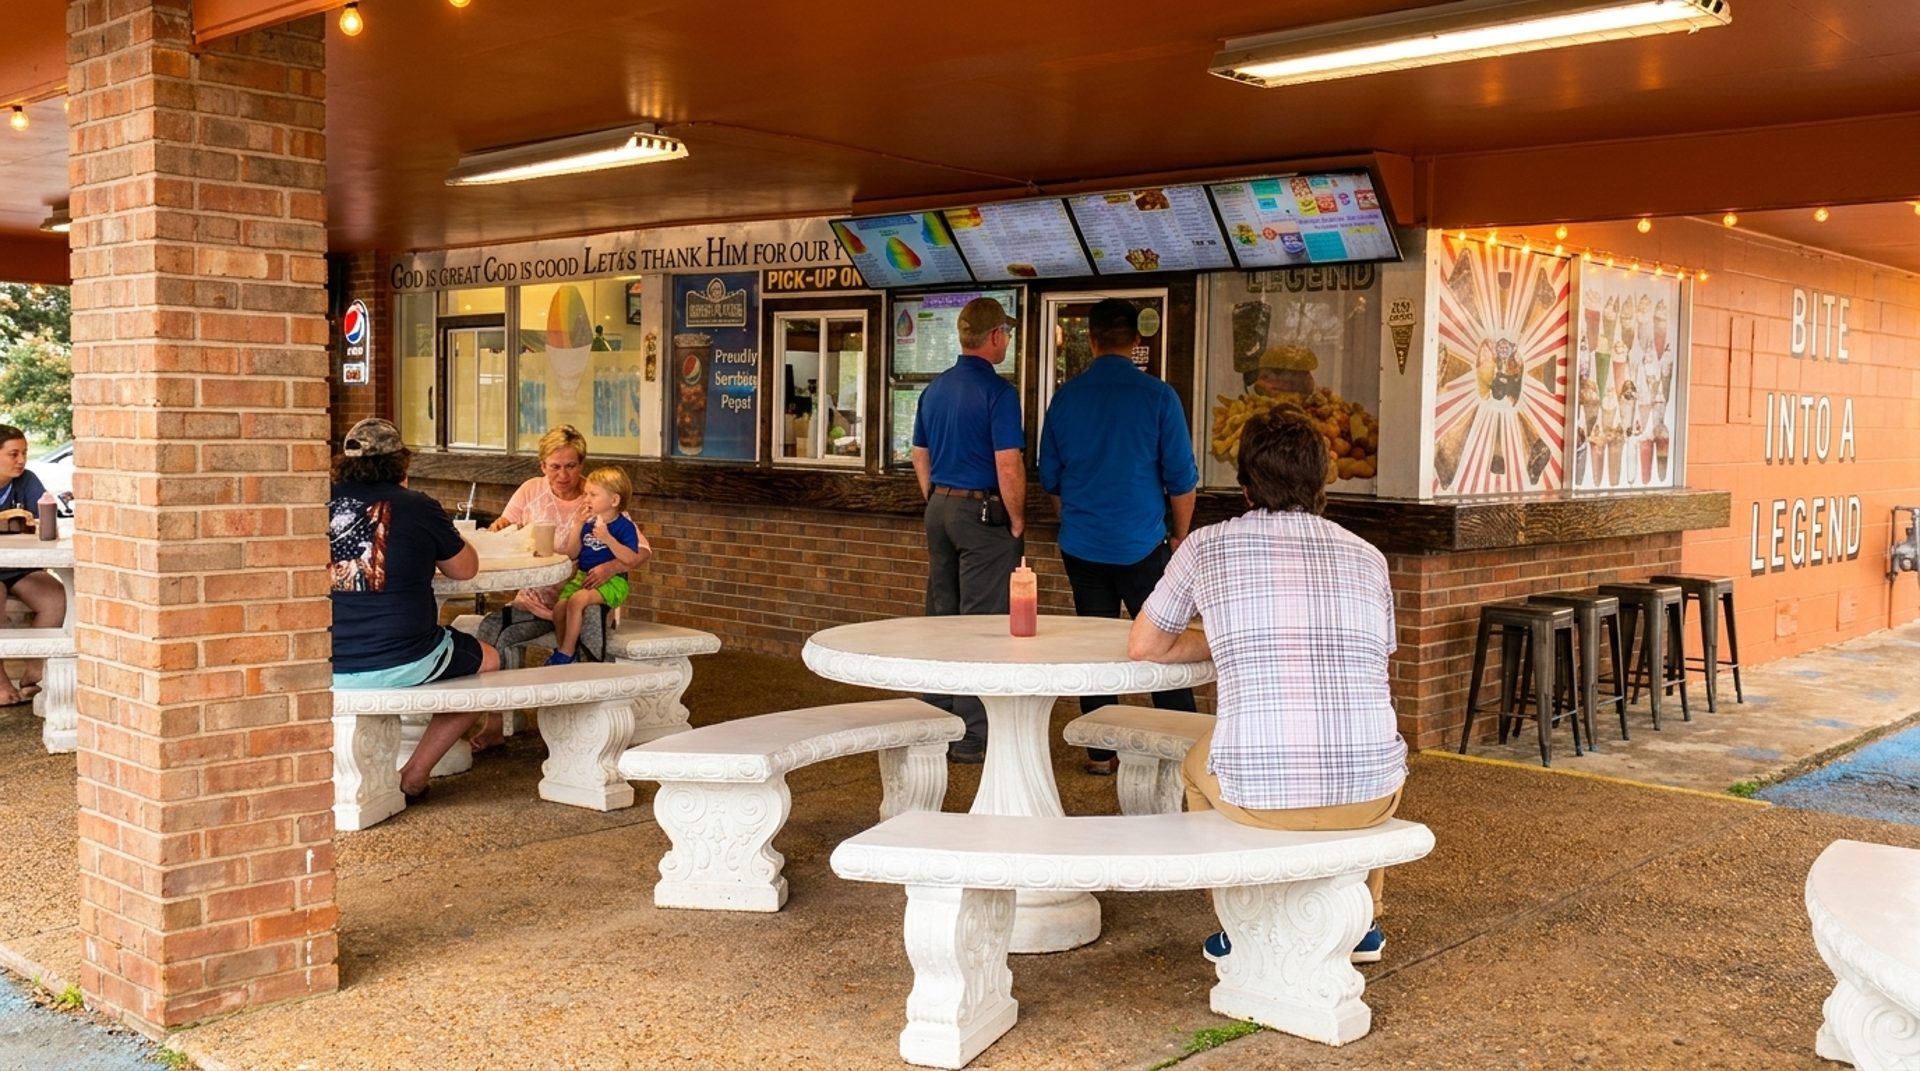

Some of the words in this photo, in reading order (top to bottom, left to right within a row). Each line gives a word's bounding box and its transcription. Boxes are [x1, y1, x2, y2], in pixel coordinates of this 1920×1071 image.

[391, 264, 423, 289] GOD
[426, 269, 436, 287] IS
[439, 265, 481, 286] GREAT
[483, 256, 516, 283] GOD
[521, 261, 531, 280] IS
[535, 257, 578, 279] GOOD
[641, 246, 702, 270] THANK
[706, 237, 748, 267] HIM
[753, 243, 786, 265] FOR
[790, 240, 829, 263] OUR
[768, 268, 836, 289] PICK-UP
[1791, 287, 1850, 361] BITE
[1765, 392, 1832, 465] INTO
[1838, 397, 1856, 463] A
[1750, 494, 1862, 576] LEGEND
